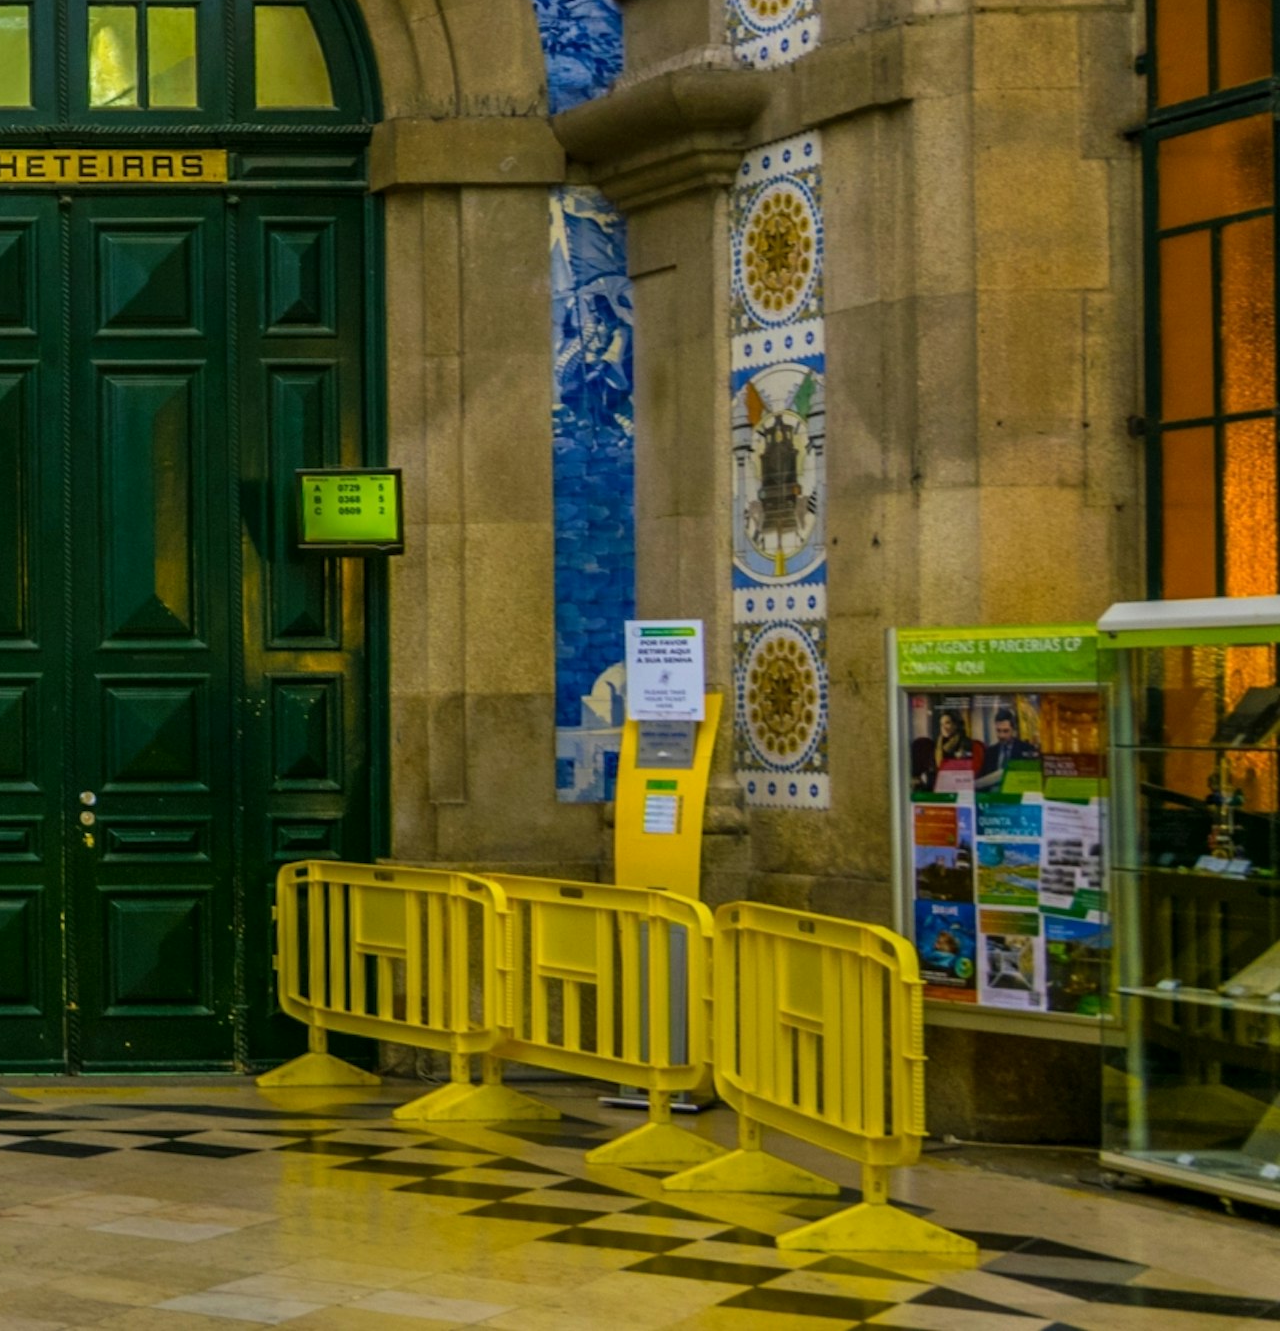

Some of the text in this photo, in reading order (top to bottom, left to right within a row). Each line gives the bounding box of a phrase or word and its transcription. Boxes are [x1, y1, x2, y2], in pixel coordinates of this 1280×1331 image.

[669, 648, 691, 656] AQUI
[900, 637, 1082, 656] VANTAGENS E PARCERIAS CP
[901, 660, 986, 676] COMPRE AQUI
